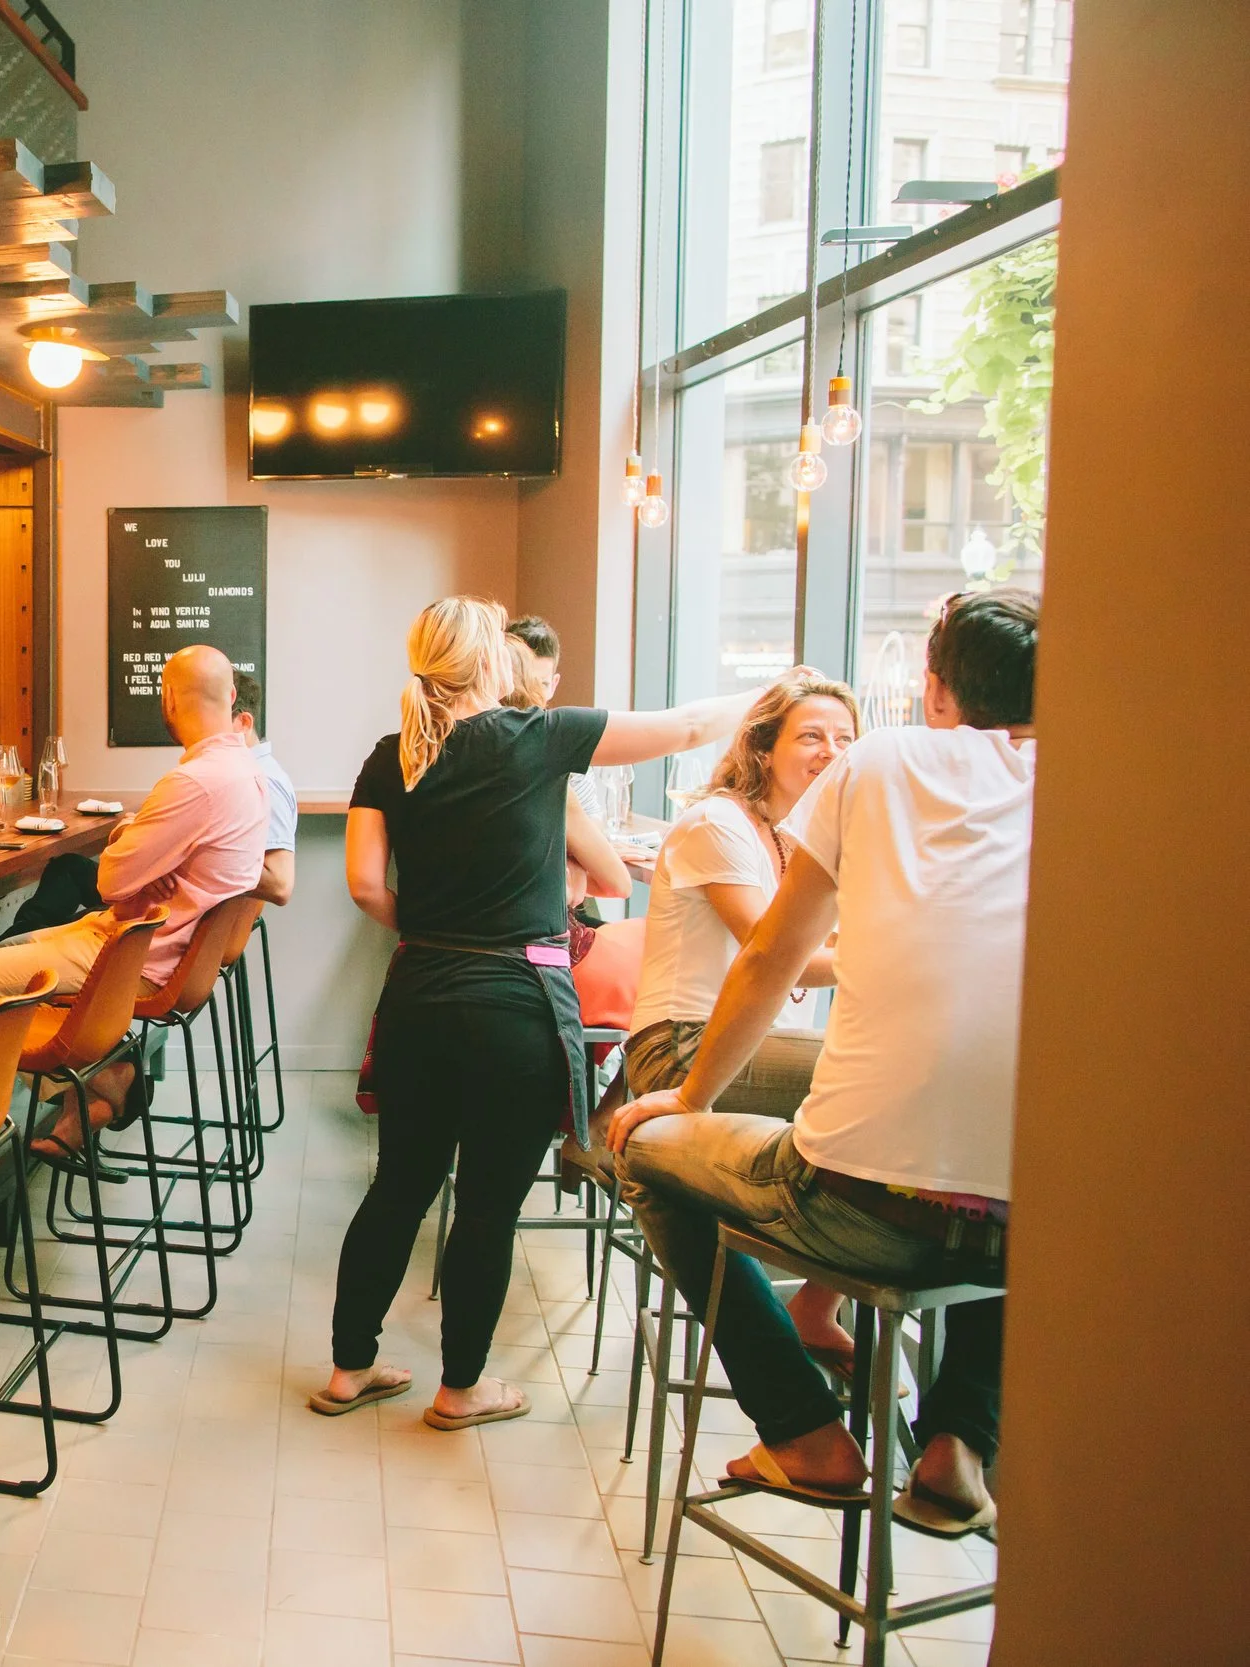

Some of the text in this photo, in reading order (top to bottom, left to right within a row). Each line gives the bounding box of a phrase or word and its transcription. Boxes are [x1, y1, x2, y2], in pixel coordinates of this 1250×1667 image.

[124, 523, 138, 532] WE
[145, 539, 168, 548] LOVE
[164, 559, 181, 568] YOU
[182, 573, 205, 582] LULU
[208, 587, 253, 596] DIAMONDS
[150, 607, 170, 616] VINO
[175, 607, 210, 616] VERITAS
[150, 620, 171, 629] AQUA
[176, 620, 210, 629] SANITAS
[123, 653, 141, 662] RED
[144, 653, 161, 662] RED
[133, 664, 149, 673] YOU
[151, 664, 166, 673] MA
[125, 675, 128, 684] I
[131, 675, 153, 684] FEEL
[129, 686, 153, 695] WHEN
